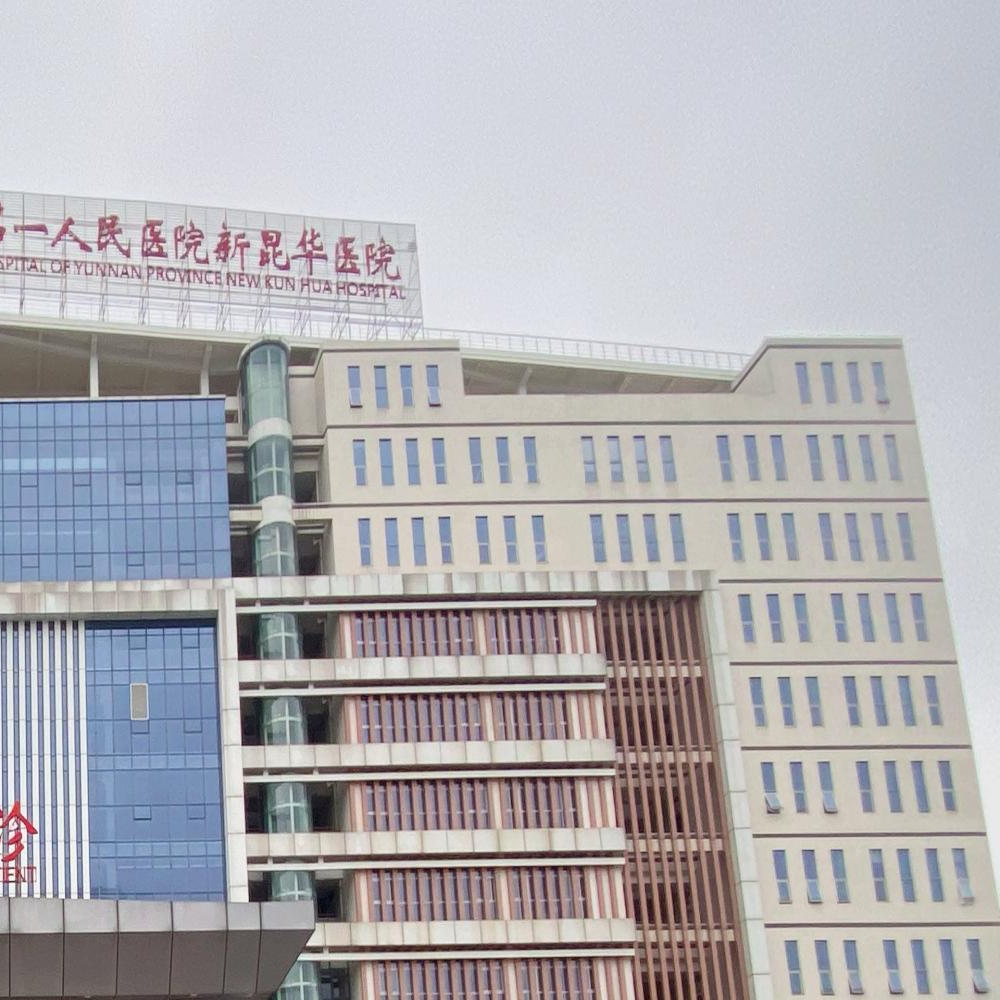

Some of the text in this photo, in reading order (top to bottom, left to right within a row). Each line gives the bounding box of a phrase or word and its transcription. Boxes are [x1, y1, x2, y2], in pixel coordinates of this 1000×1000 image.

[51, 259, 73, 274] OF
[74, 260, 142, 279] YUNNAN
[147, 266, 222, 285] PROVINCE
[226, 273, 260, 289] NEW
[264, 275, 296, 291] KUN
[300, 278, 333, 295] HUA
[336, 282, 407, 300] HOSPITAL
